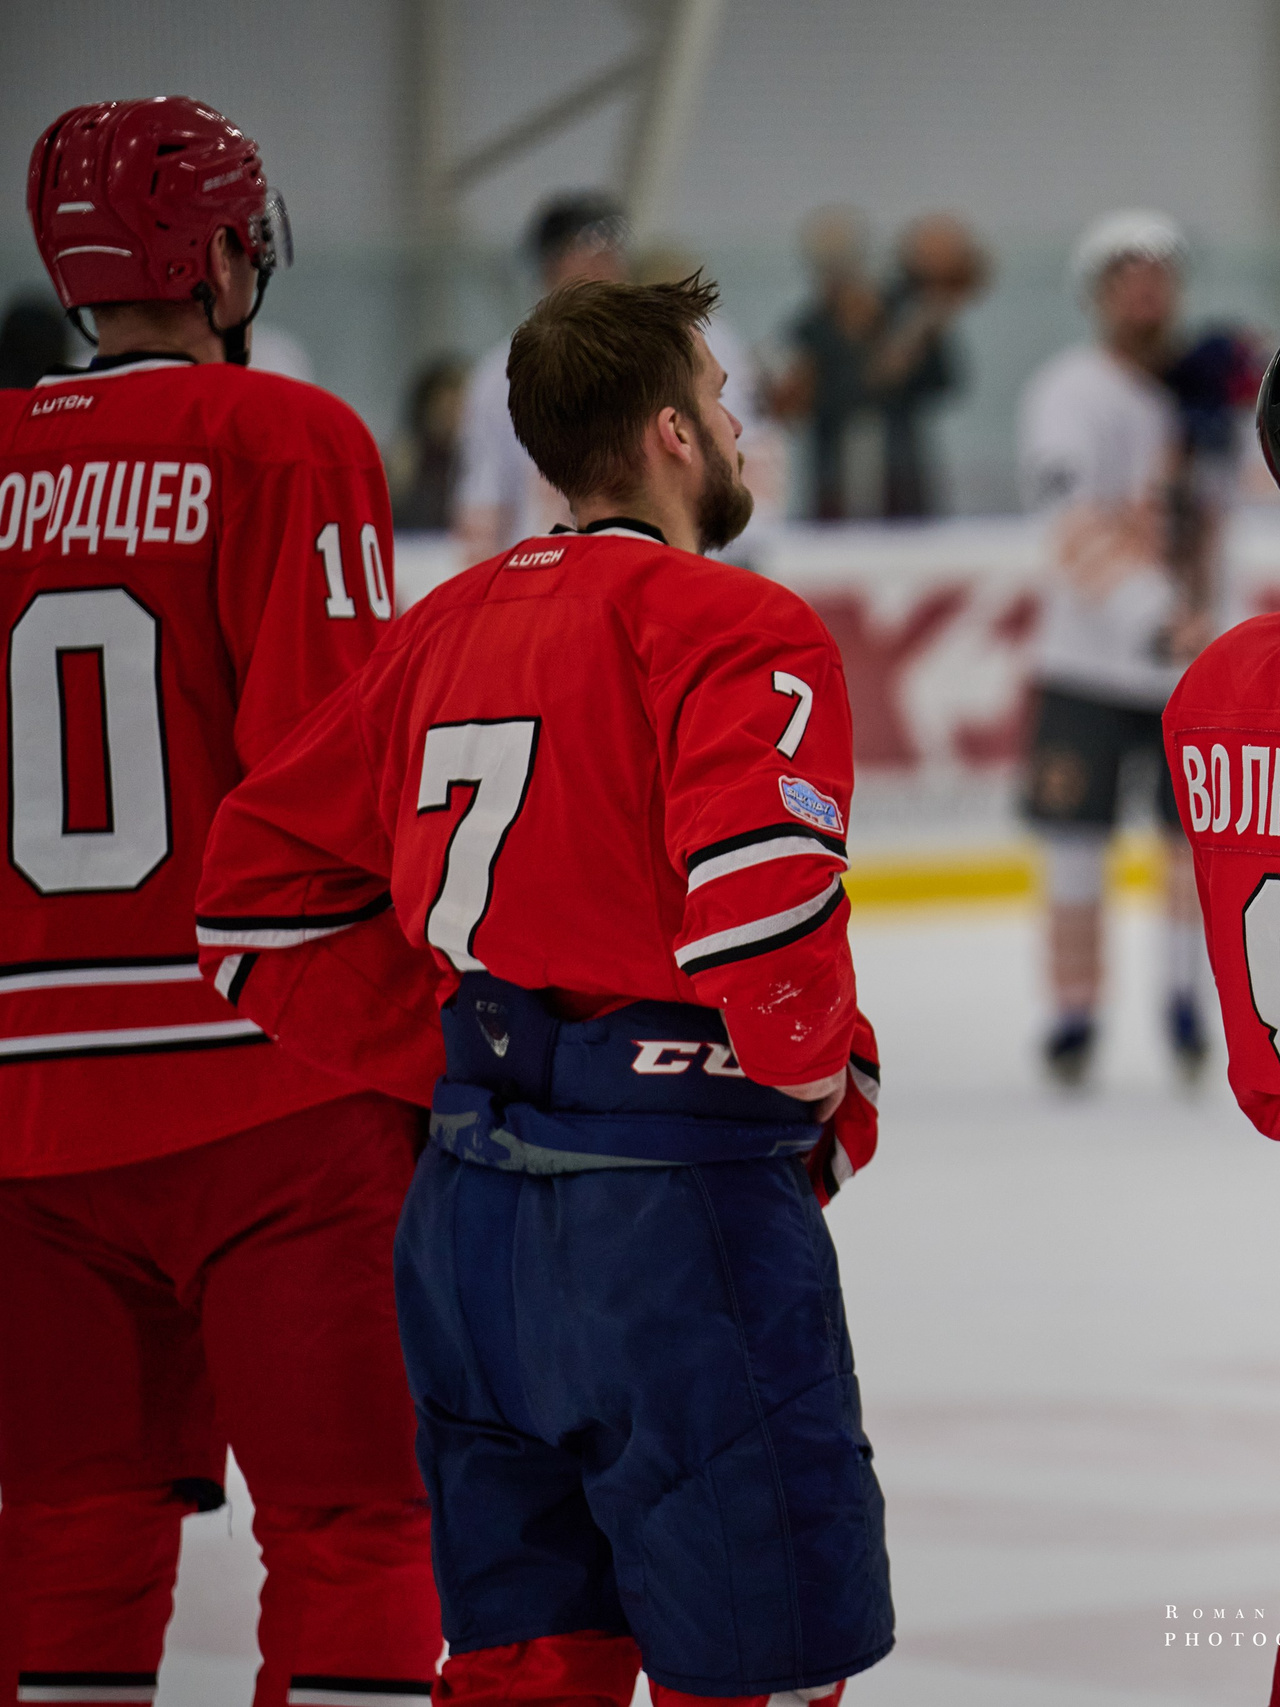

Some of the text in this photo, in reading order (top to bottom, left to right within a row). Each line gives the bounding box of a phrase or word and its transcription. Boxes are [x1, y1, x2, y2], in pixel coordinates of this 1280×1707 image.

[315, 522, 392, 621] 10
[508, 548, 565, 567] LUTCH
[8, 584, 173, 895] 0
[771, 670, 814, 762] 7
[417, 715, 542, 973] 7
